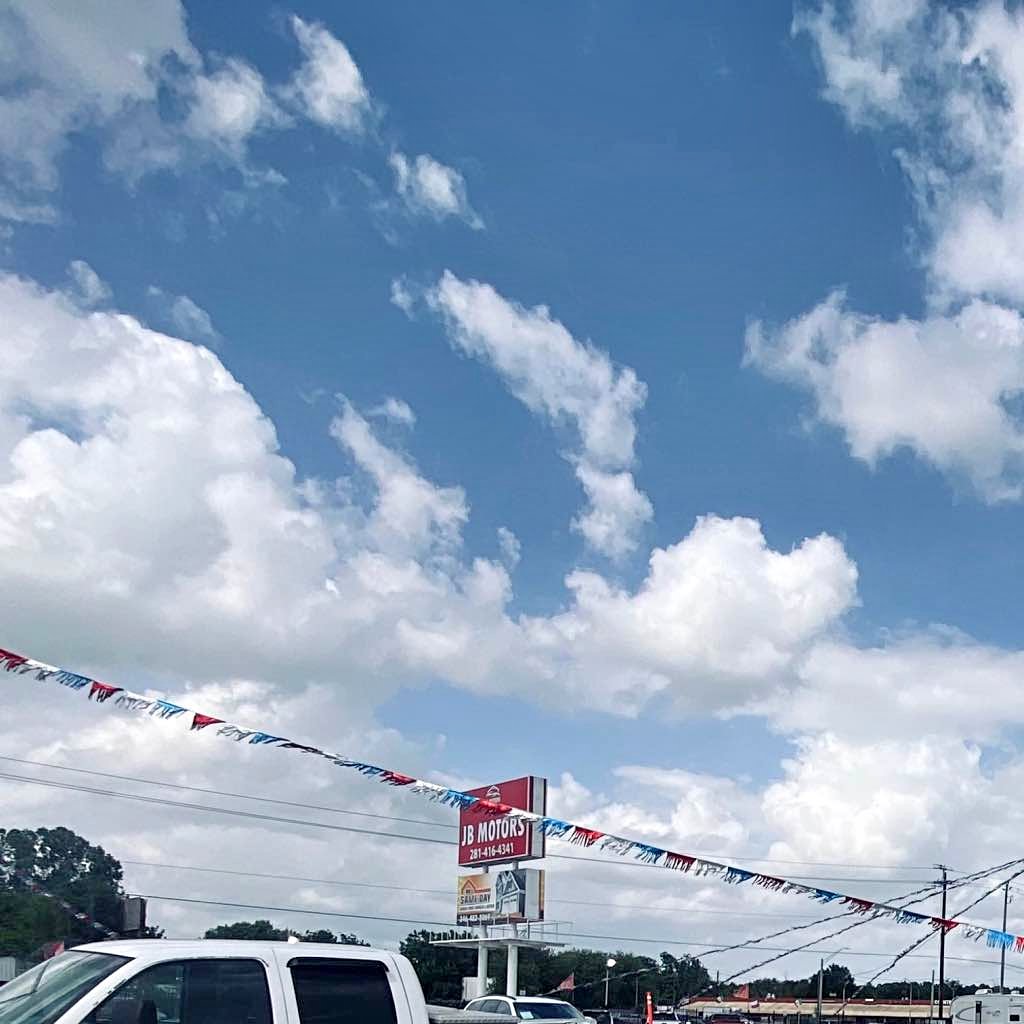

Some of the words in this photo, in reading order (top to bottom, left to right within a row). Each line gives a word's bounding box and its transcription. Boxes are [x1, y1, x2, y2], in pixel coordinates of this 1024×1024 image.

[462, 825, 474, 846] JB
[477, 818, 525, 844] MOTORS
[469, 843, 514, 860] 281-416-4341
